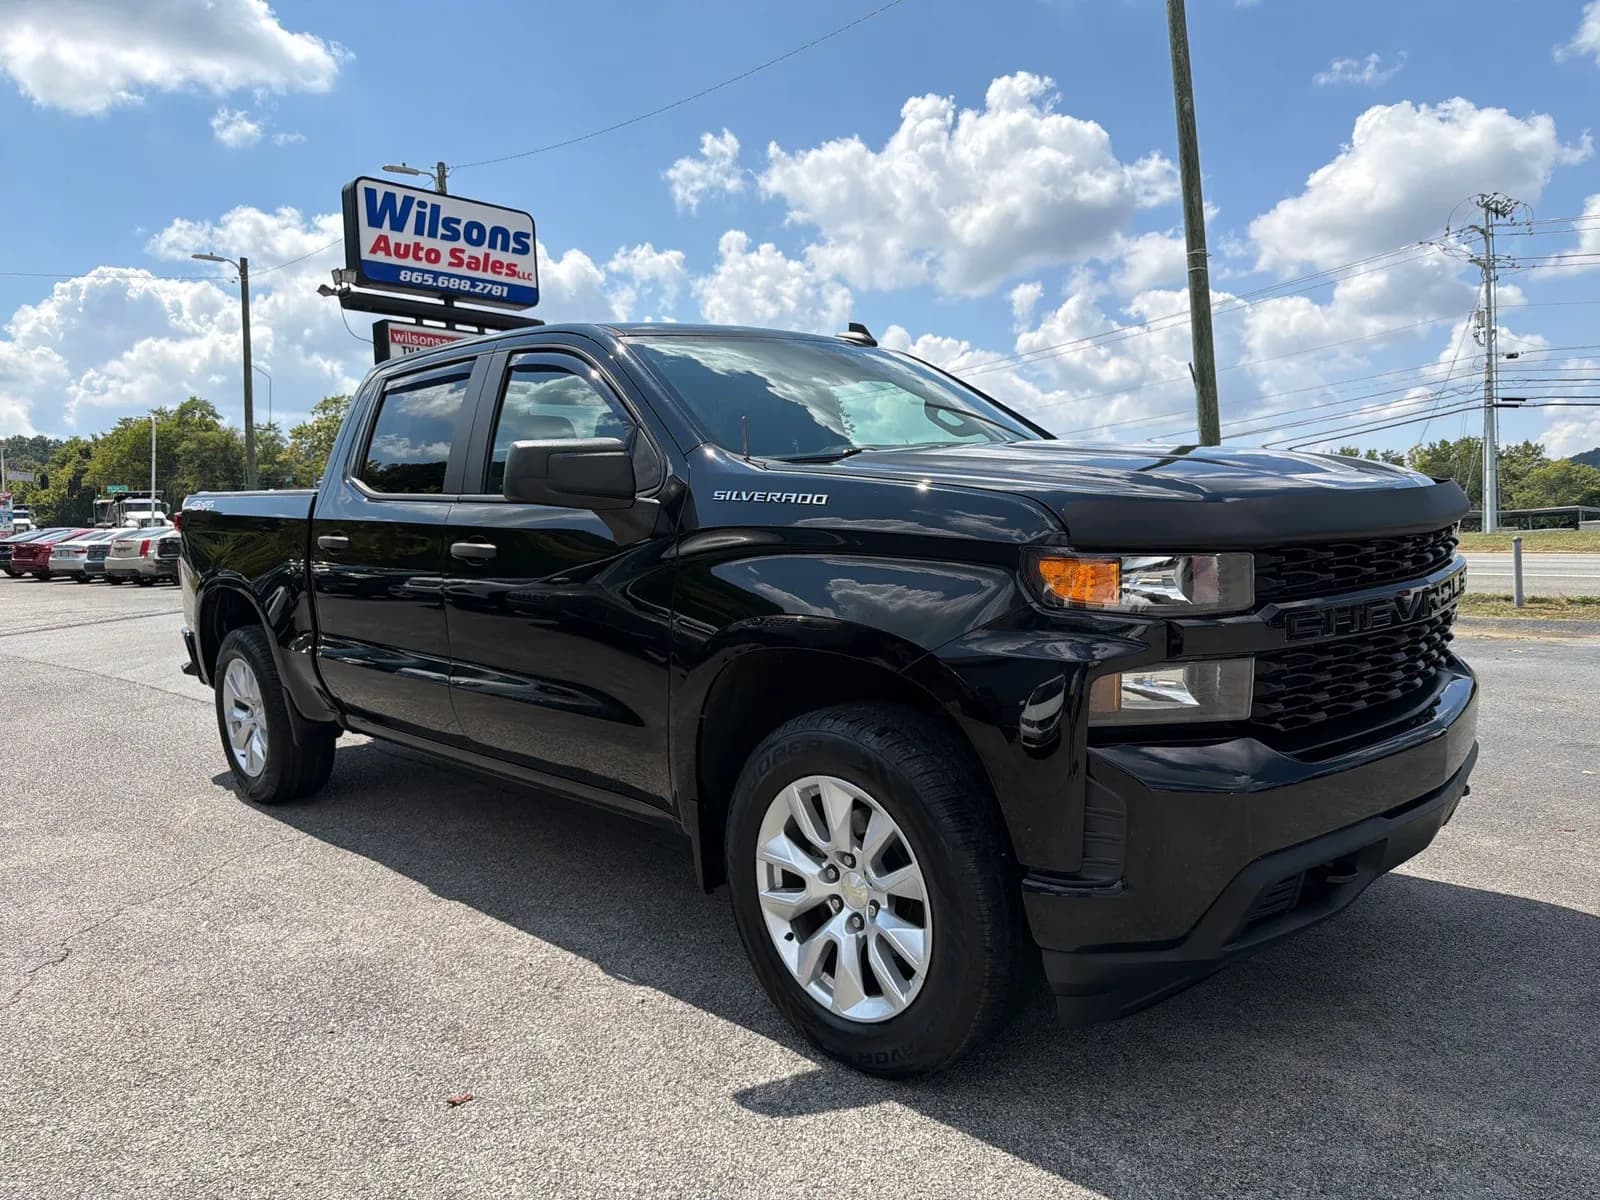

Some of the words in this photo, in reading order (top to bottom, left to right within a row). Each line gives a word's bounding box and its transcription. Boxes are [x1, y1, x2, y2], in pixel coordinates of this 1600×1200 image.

[364, 187, 531, 256] Wilsons
[369, 234, 441, 265] Auto
[448, 247, 518, 278] Sales
[517, 270, 533, 281] LLC
[399, 269, 509, 297] 865.688.2781
[712, 490, 829, 505] SILVERADO
[1285, 566, 1467, 642] CHEVROLE
